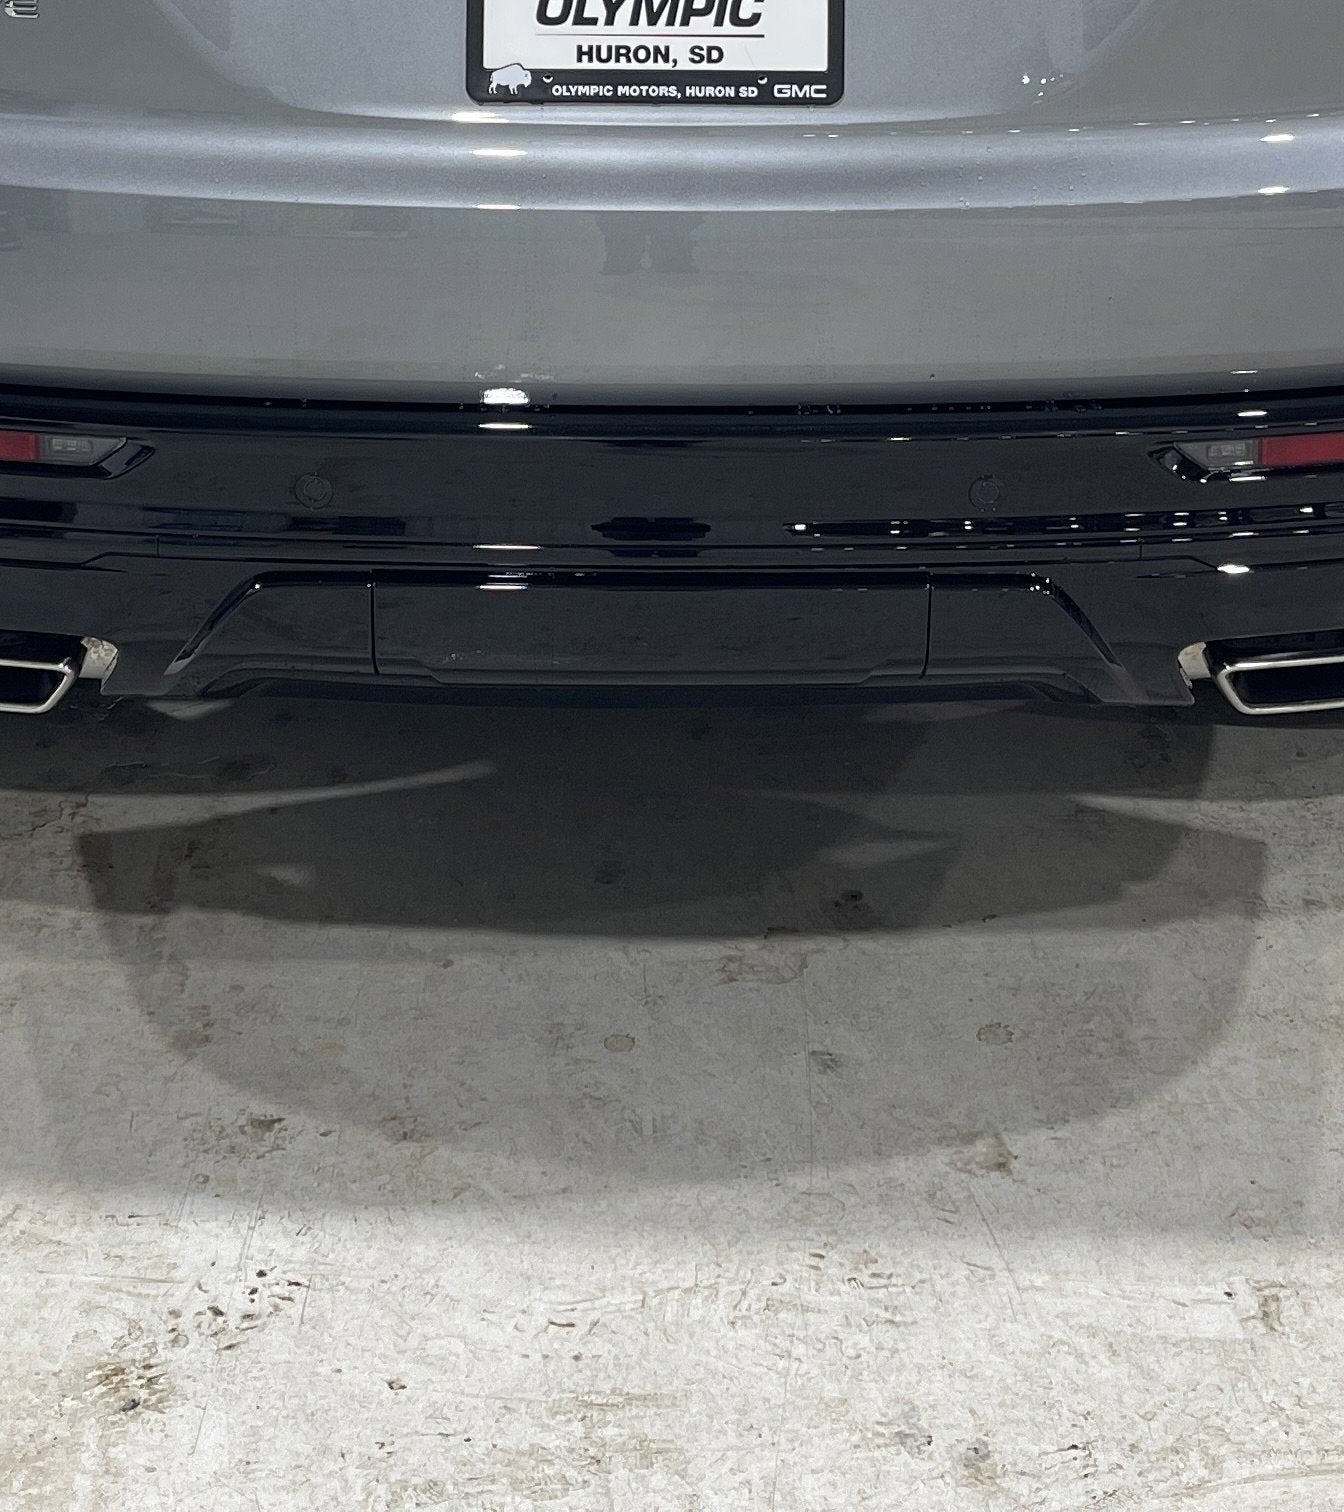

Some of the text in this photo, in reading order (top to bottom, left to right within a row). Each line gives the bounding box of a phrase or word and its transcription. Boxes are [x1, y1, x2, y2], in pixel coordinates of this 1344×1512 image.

[575, 44, 725, 69] HURON, SD
[551, 84, 758, 100] OLYMPIC MOTORS, HURON SD
[773, 83, 828, 99] GMC
